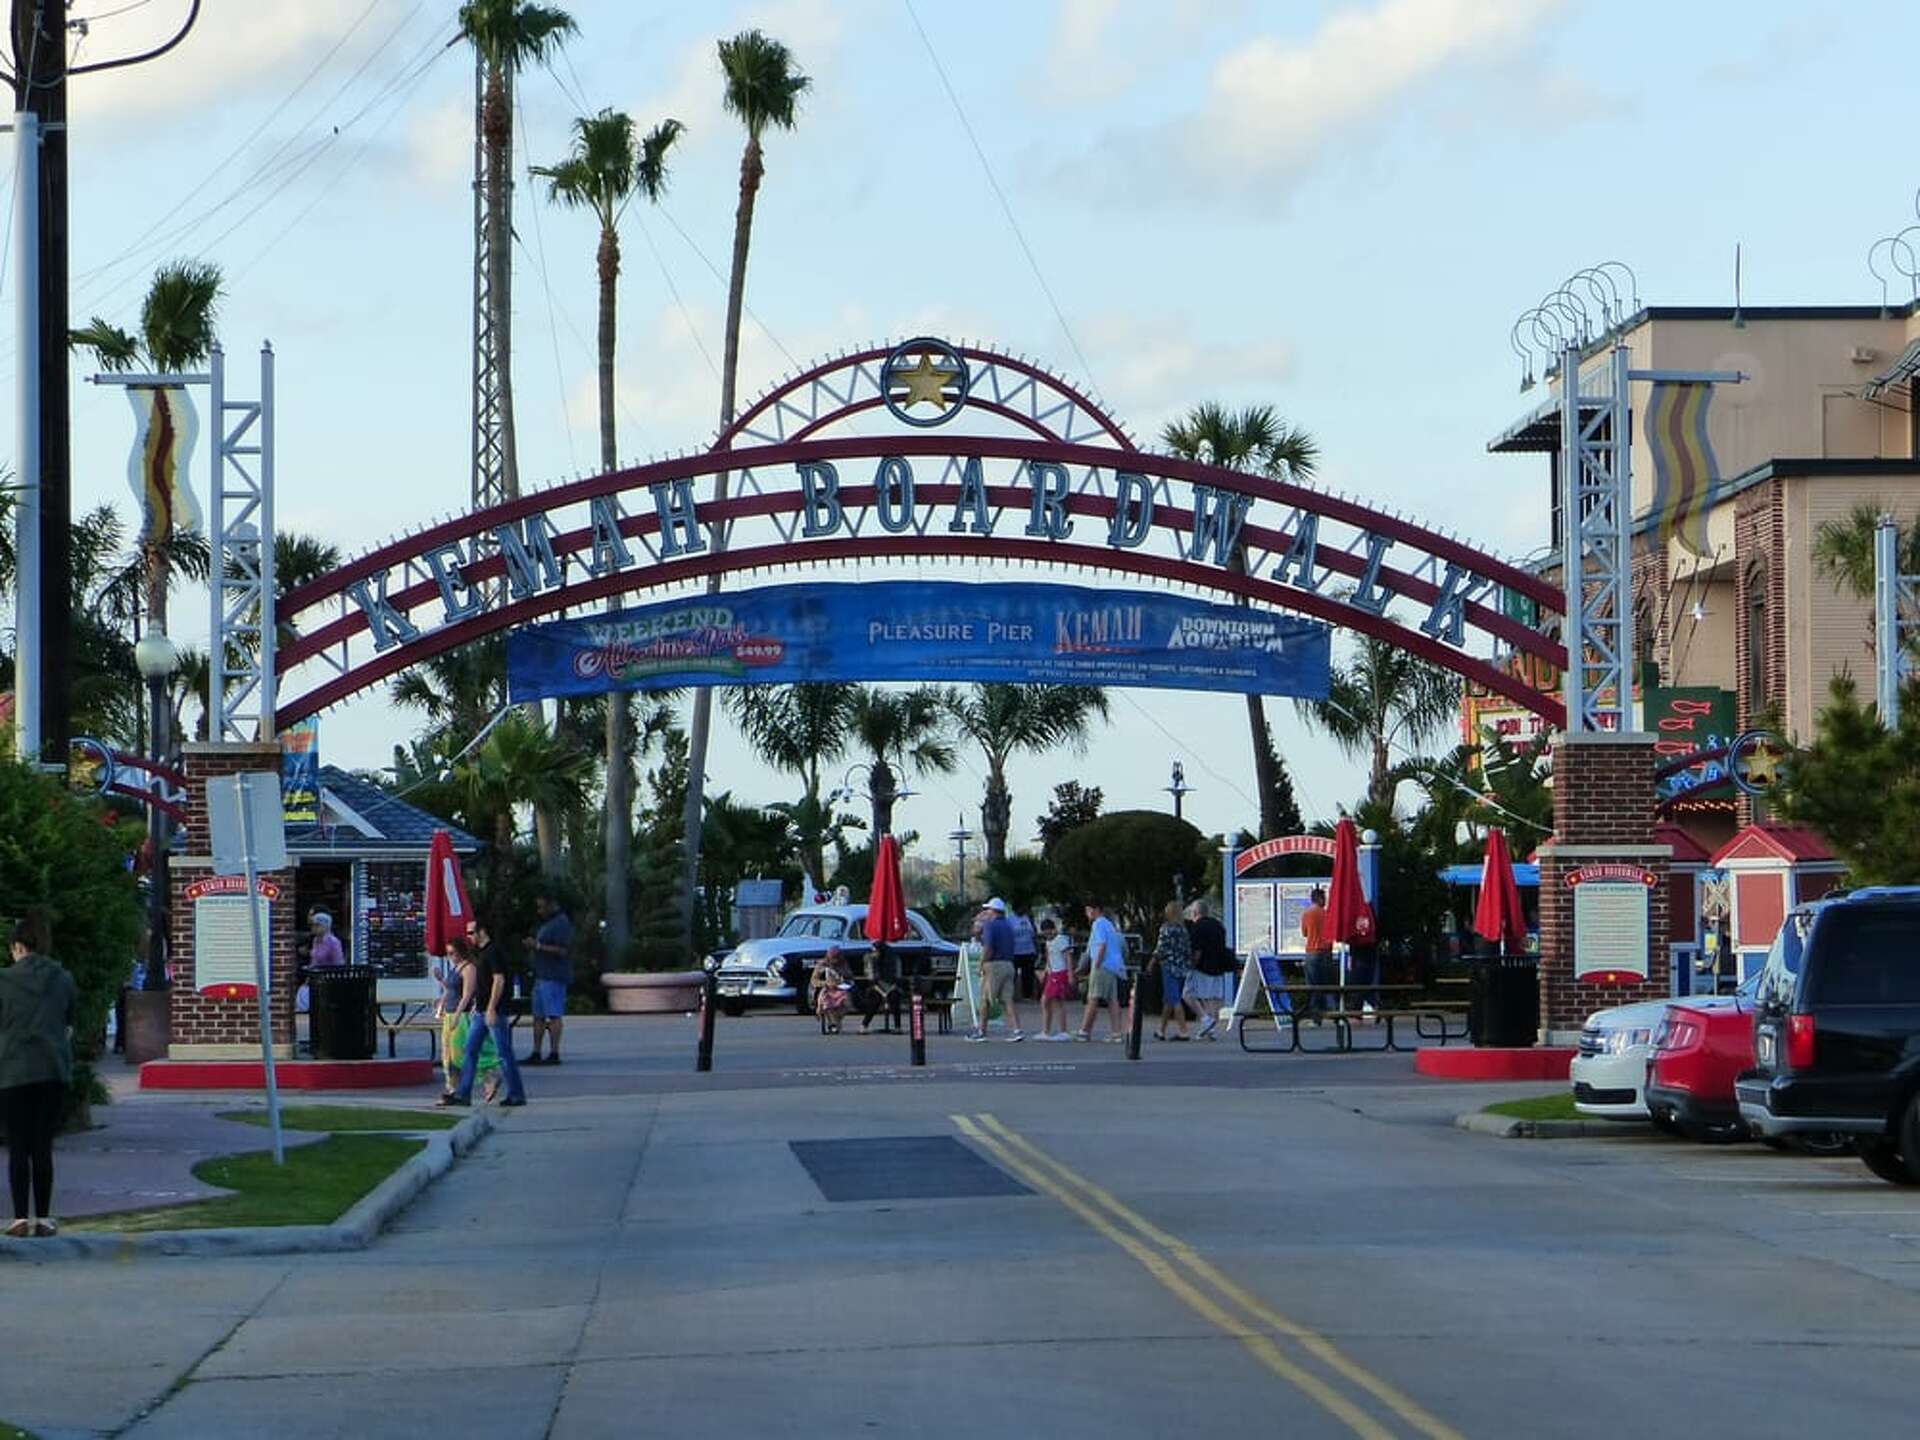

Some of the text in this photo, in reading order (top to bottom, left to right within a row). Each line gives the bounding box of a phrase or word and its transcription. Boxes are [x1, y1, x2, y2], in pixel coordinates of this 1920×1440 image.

[346, 456, 1494, 654] KEMAH BOARDWALK
[584, 607, 734, 645] WEEKEND
[1056, 606, 1141, 654] KEMAH
[1168, 625, 1283, 653] AQUARIUM
[1182, 617, 1275, 635] DOWNTOWN
